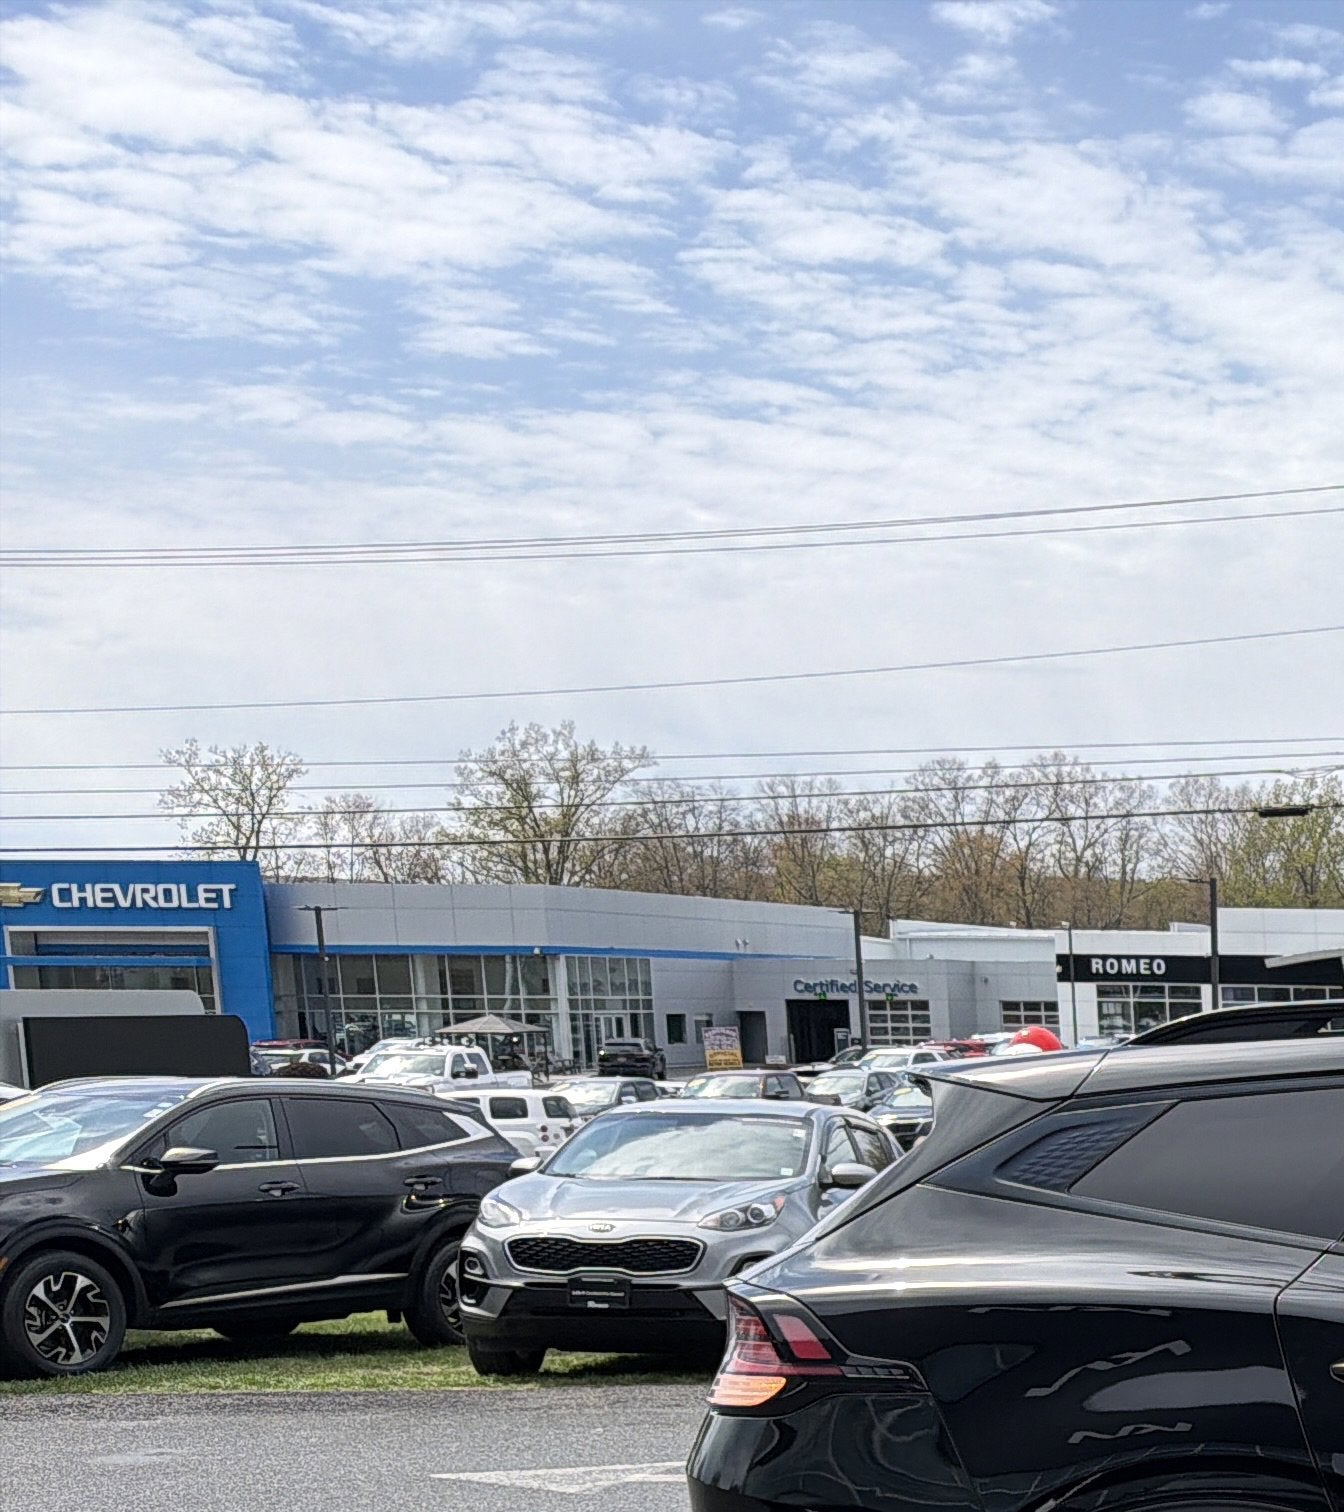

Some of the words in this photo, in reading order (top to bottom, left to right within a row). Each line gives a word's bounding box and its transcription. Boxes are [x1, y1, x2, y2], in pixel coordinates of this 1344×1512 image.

[51, 883, 237, 909] CHEVROLET
[1090, 957, 1166, 975] ROMEO
[793, 979, 858, 994] Certified
[863, 979, 919, 994] Service
